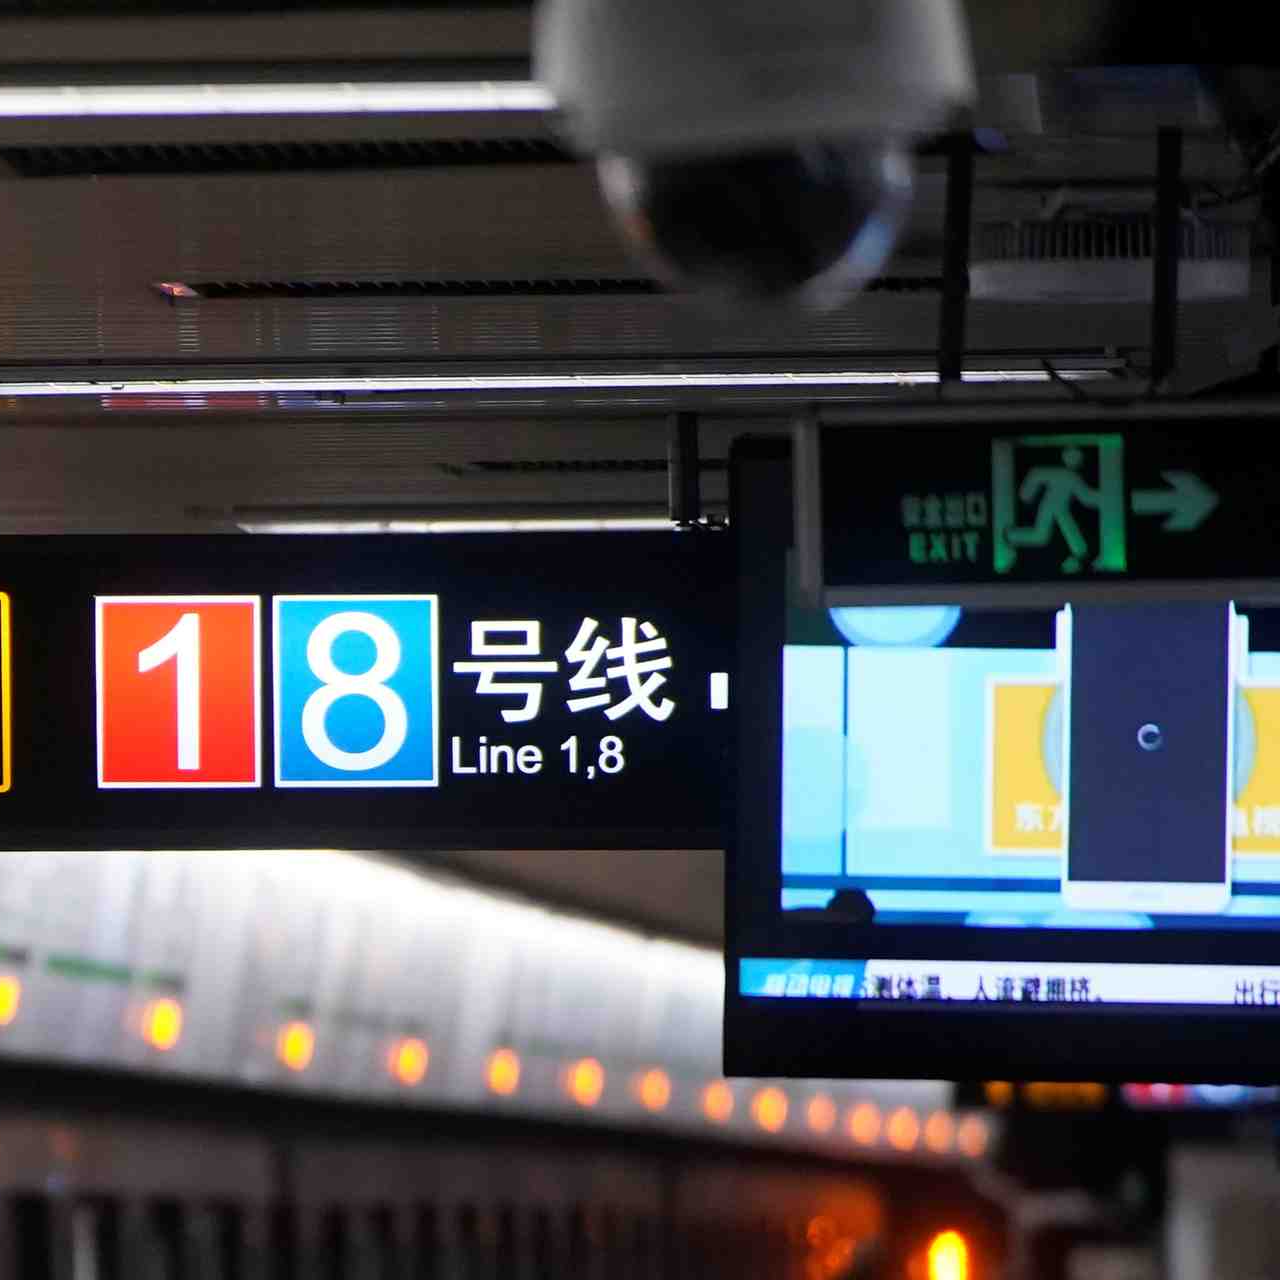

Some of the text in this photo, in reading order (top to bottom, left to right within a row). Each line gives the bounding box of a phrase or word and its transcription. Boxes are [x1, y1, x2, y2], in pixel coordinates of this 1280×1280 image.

[138, 611, 676, 771] 1 8 号线
[452, 735, 625, 780] Line 1,8
